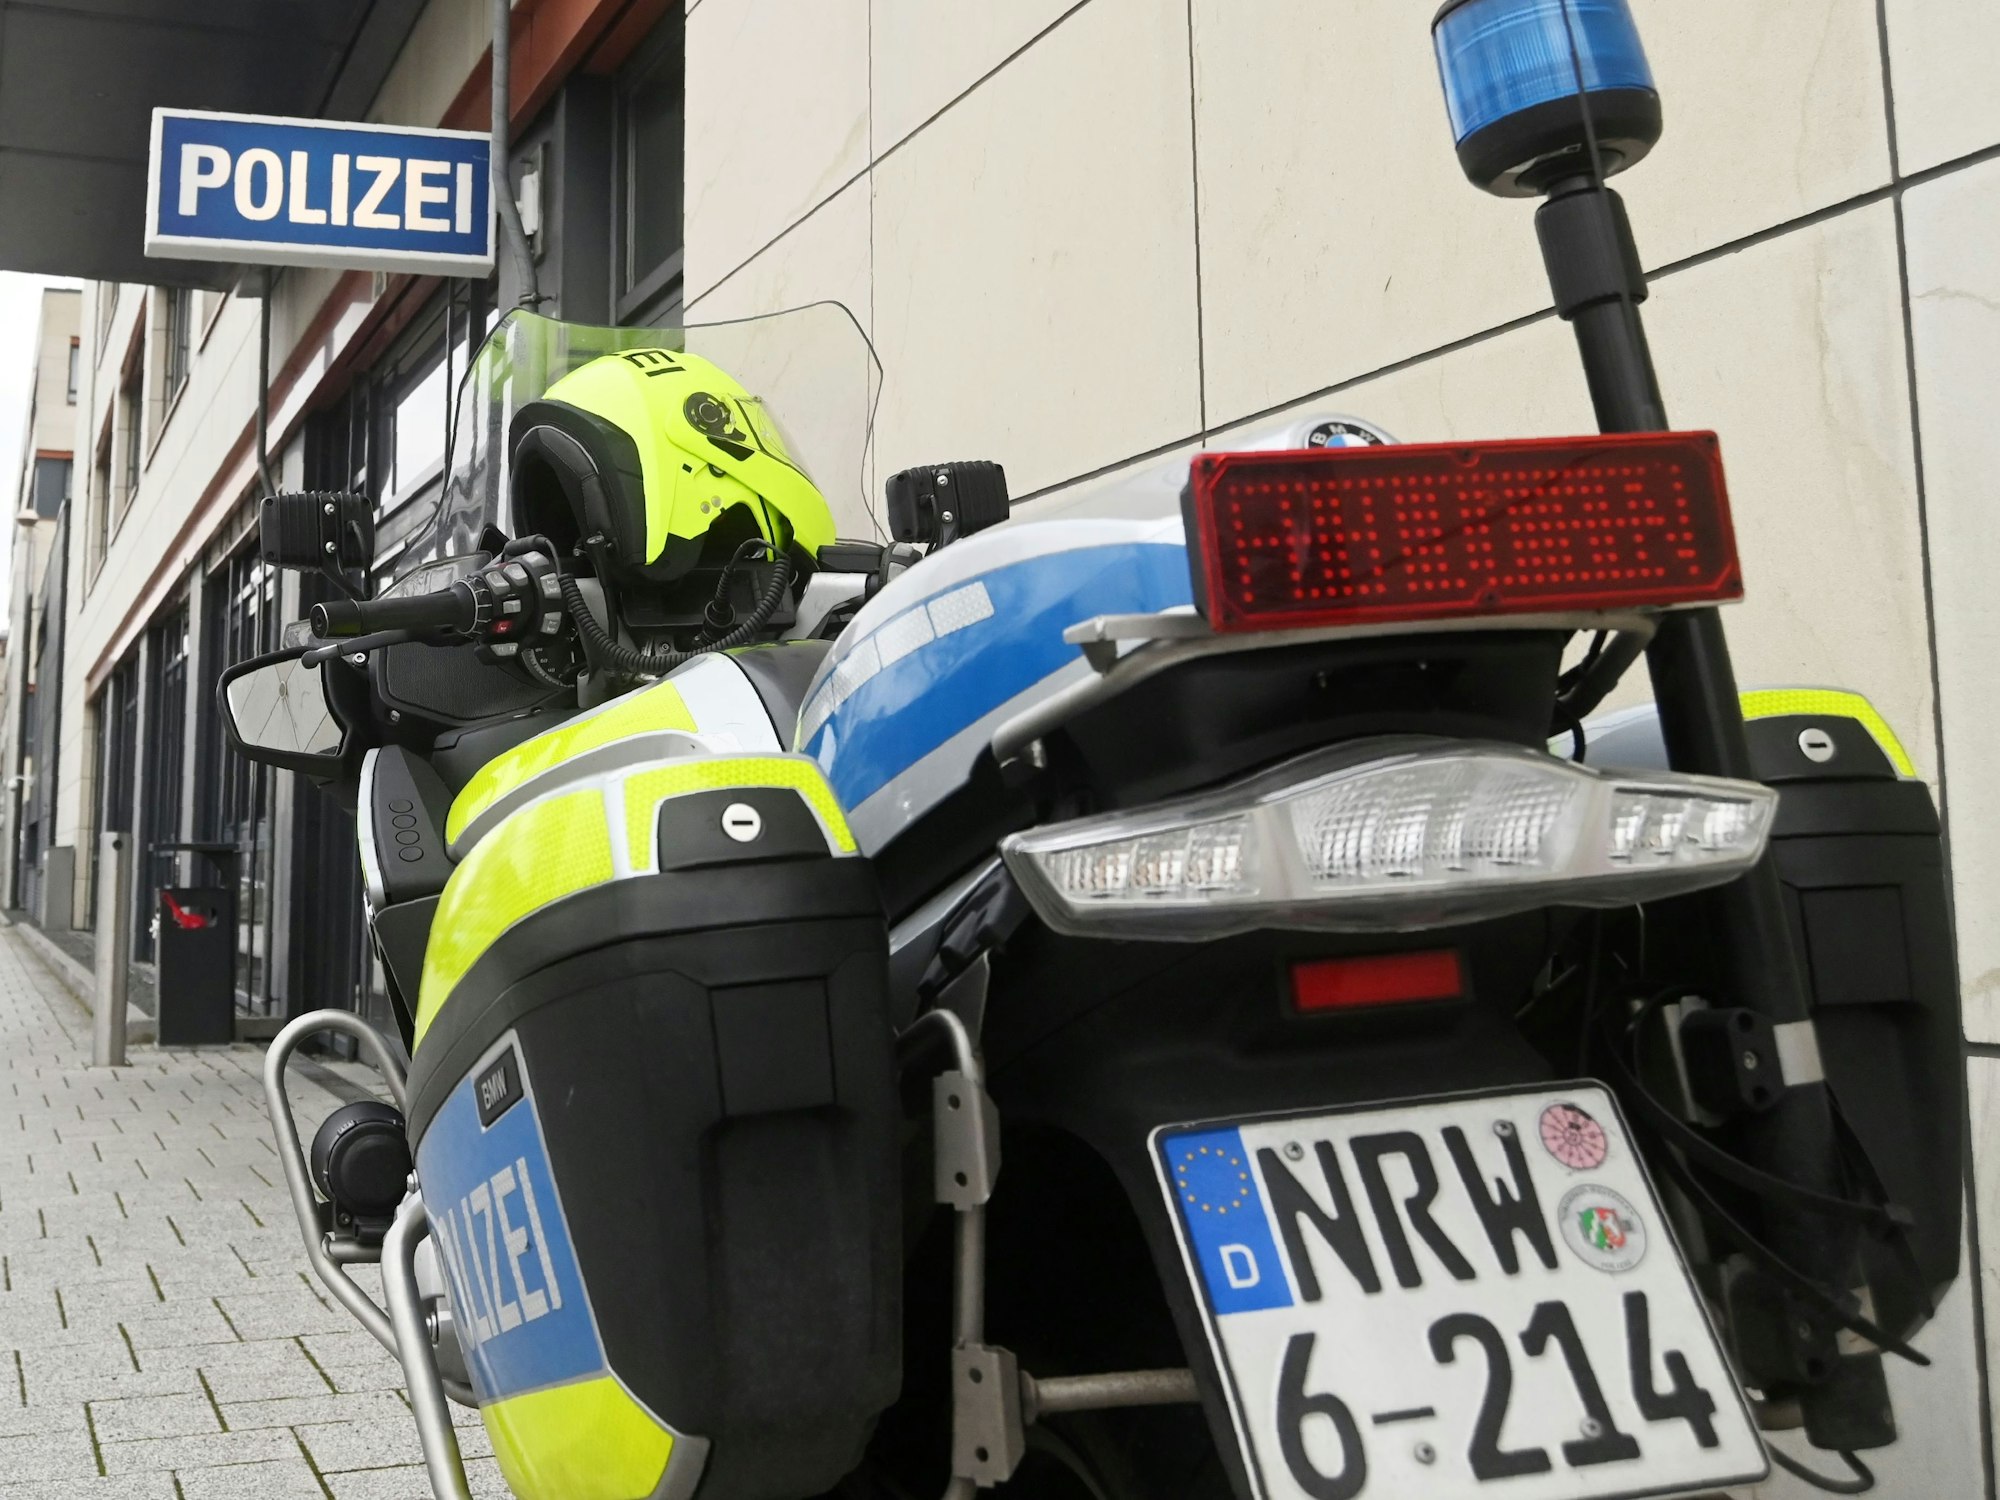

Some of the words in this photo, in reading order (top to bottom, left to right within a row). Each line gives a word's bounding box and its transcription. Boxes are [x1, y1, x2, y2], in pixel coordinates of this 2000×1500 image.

[178, 143, 473, 234] POLIZEI
[1311, 424, 1376, 445] BMW
[481, 1066, 507, 1110] BMW
[1257, 1121, 1559, 1303] NRW
[1219, 1243, 1261, 1289] D
[1276, 1290, 1720, 1500] 6-214
